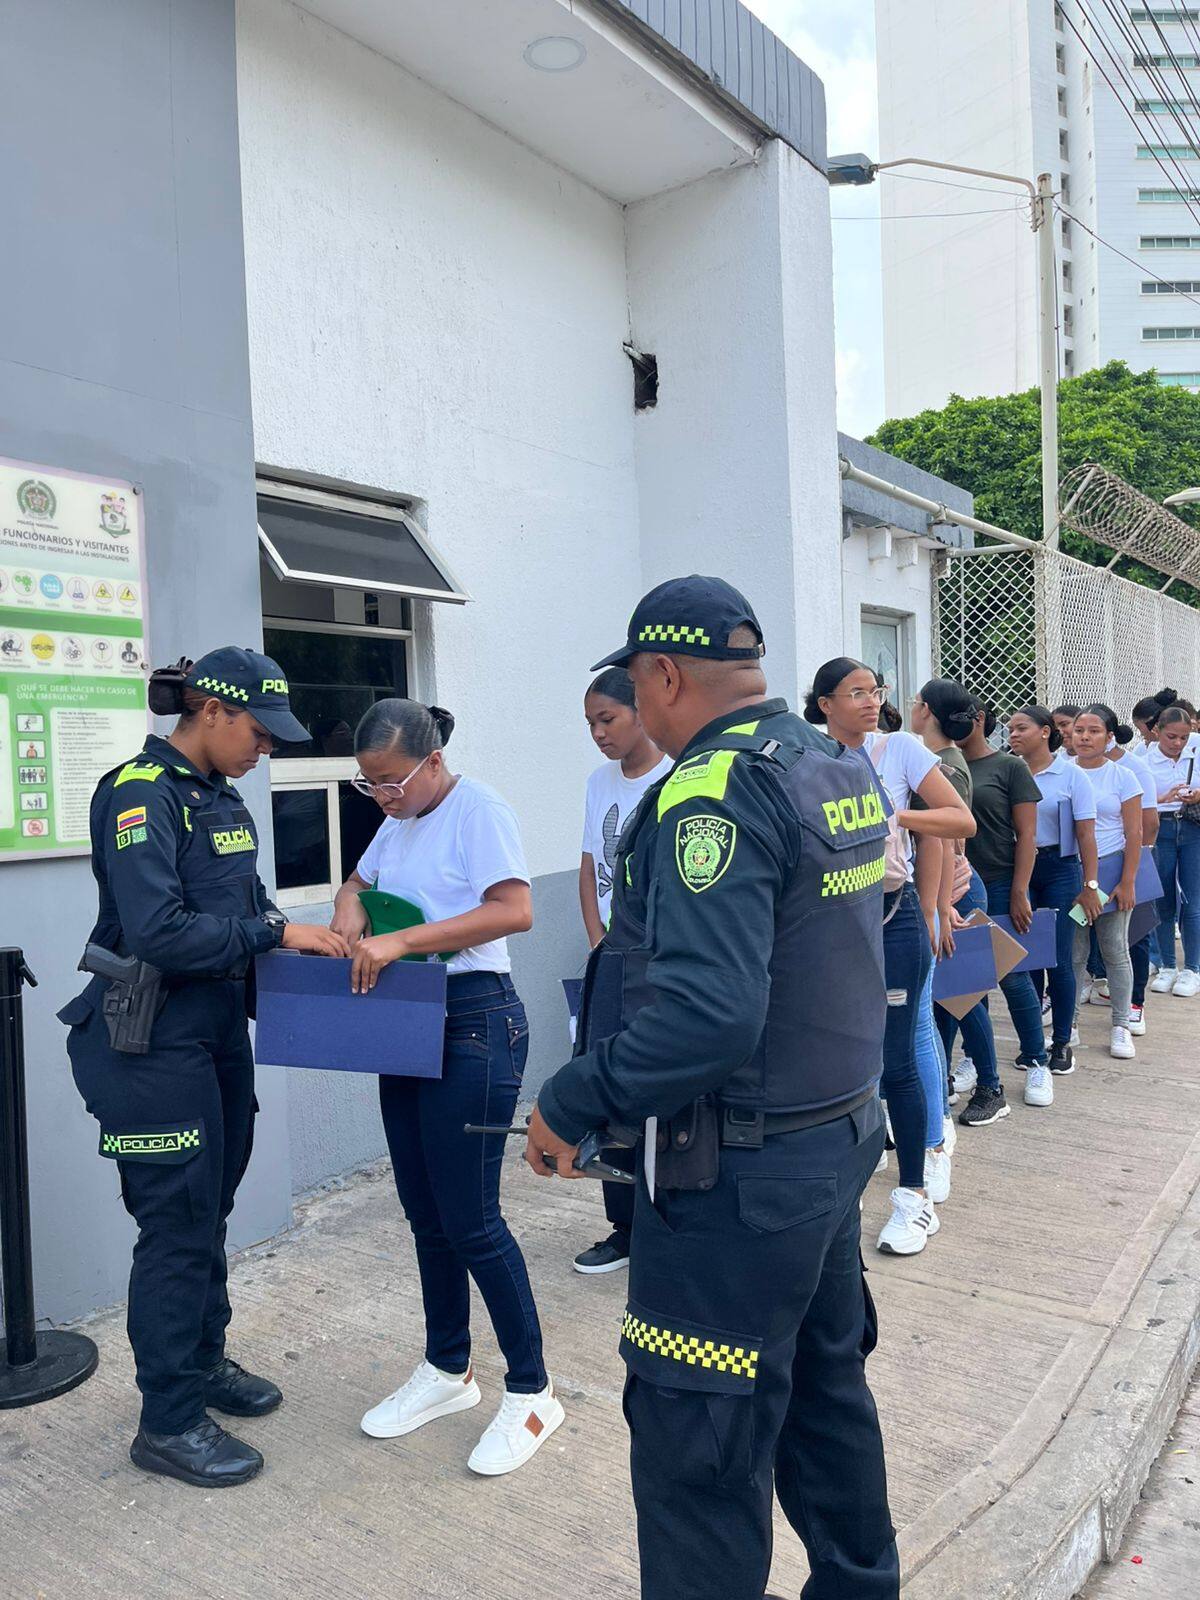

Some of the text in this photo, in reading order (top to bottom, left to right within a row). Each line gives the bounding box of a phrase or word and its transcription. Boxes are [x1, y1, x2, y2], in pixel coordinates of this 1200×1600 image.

[3, 528, 130, 555] FUNCIONARIOS Y VISITANTES
[106, 687, 126, 695] CASO
[680, 828, 729, 849] NACIONAL
[122, 1137, 176, 1149] POLICÍA
